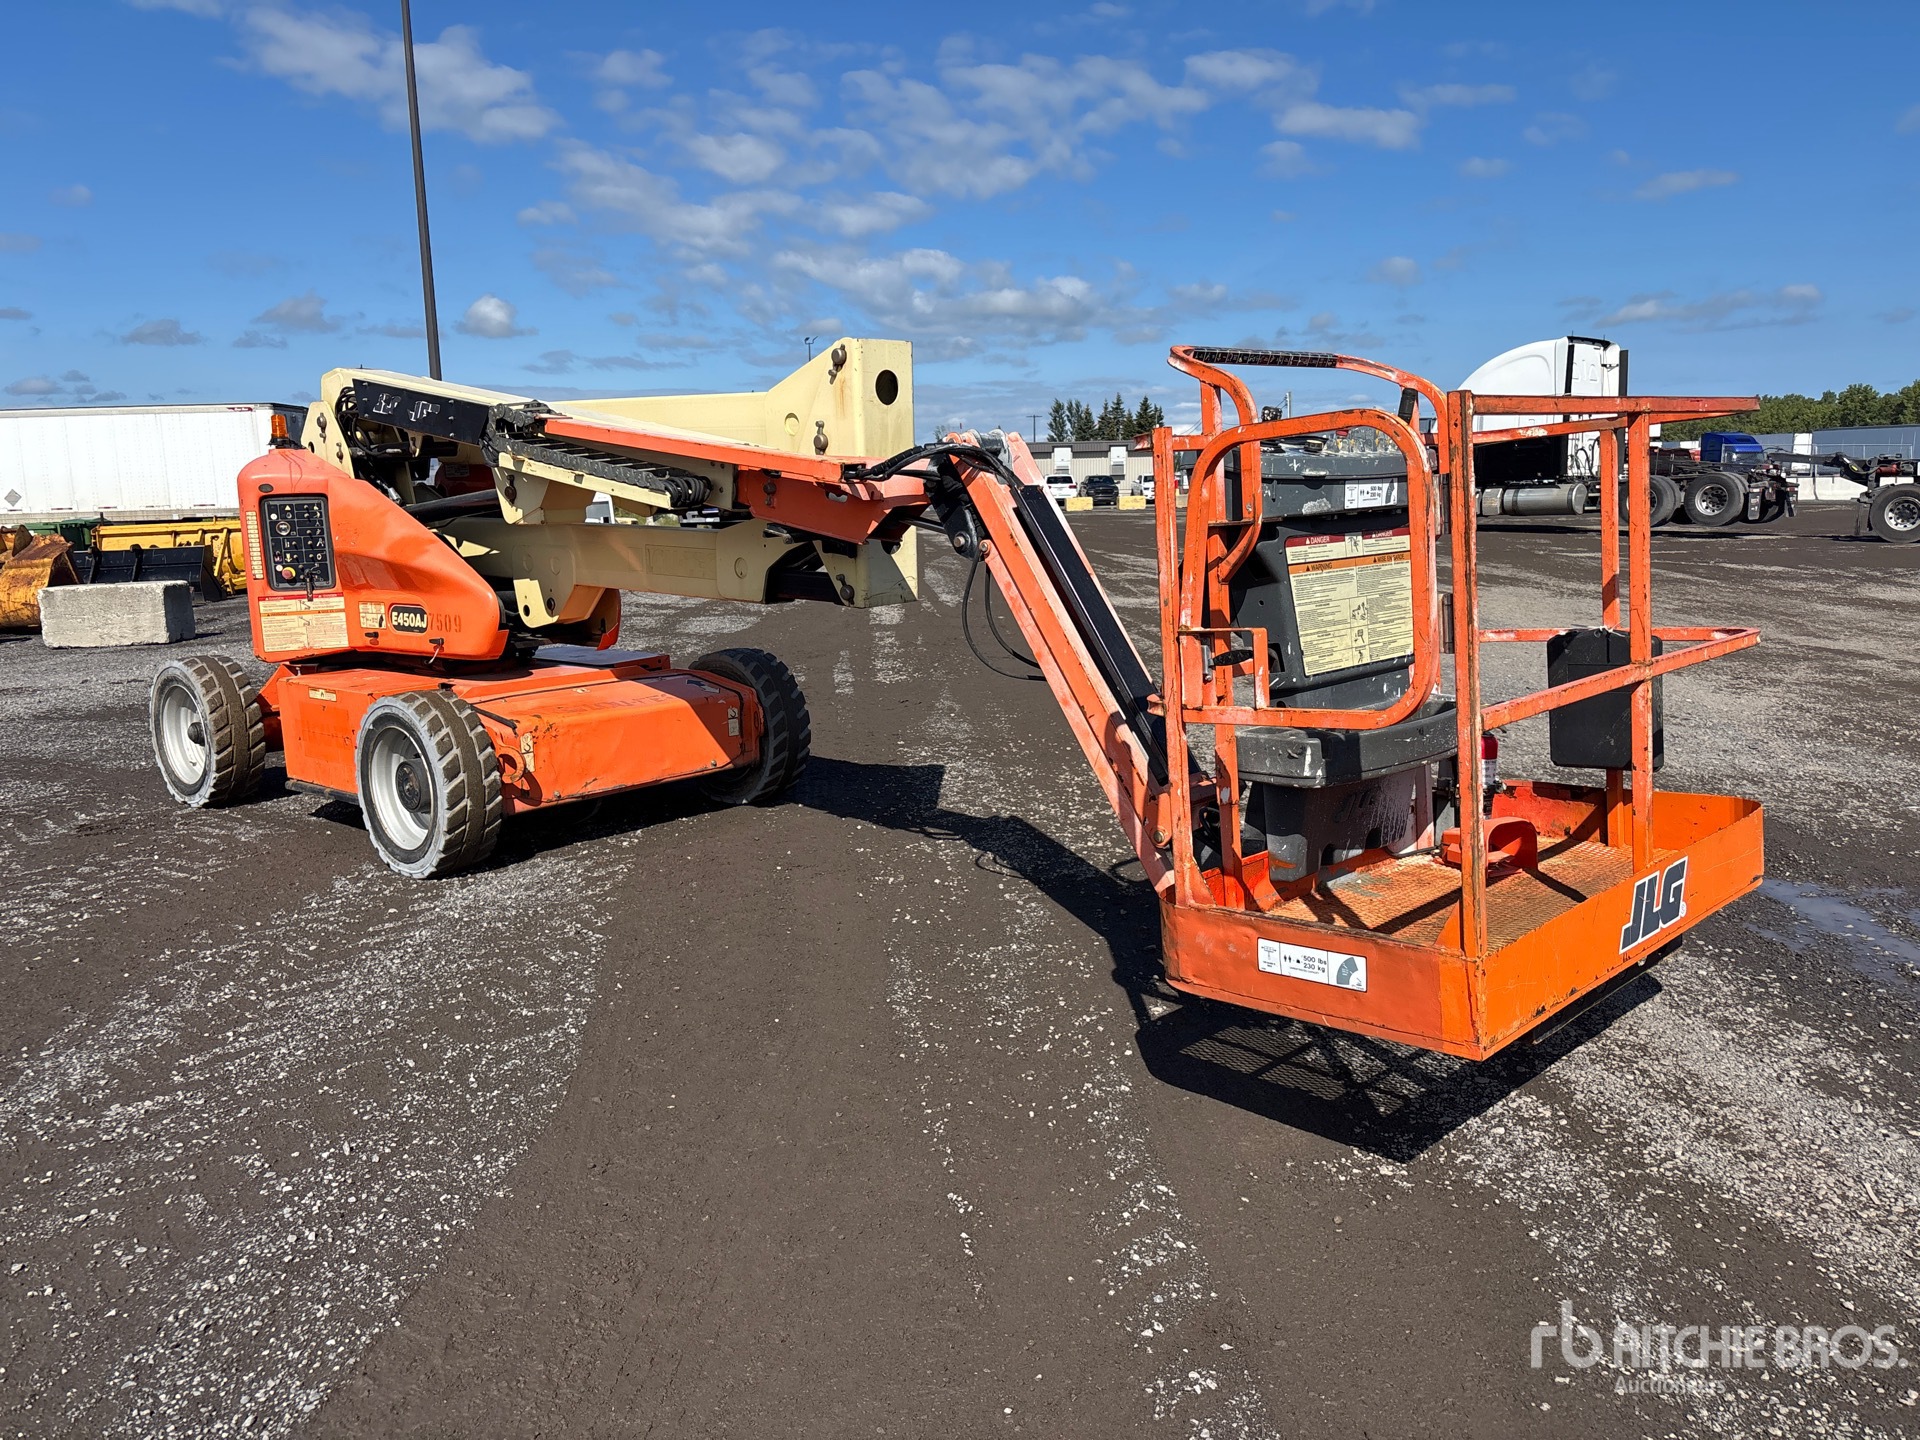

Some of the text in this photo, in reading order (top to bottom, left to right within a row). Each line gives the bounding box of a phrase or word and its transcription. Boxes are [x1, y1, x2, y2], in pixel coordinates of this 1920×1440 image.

[1310, 535, 1330, 545] DANGER
[1310, 561, 1333, 572] WARNING
[391, 611, 427, 628] E450AJ
[429, 613, 462, 633] 7509
[1619, 856, 1688, 955] JLG
[1303, 955, 1327, 965] 500 lbs
[1303, 962, 1316, 970] 230
[1317, 964, 1326, 973] kg
